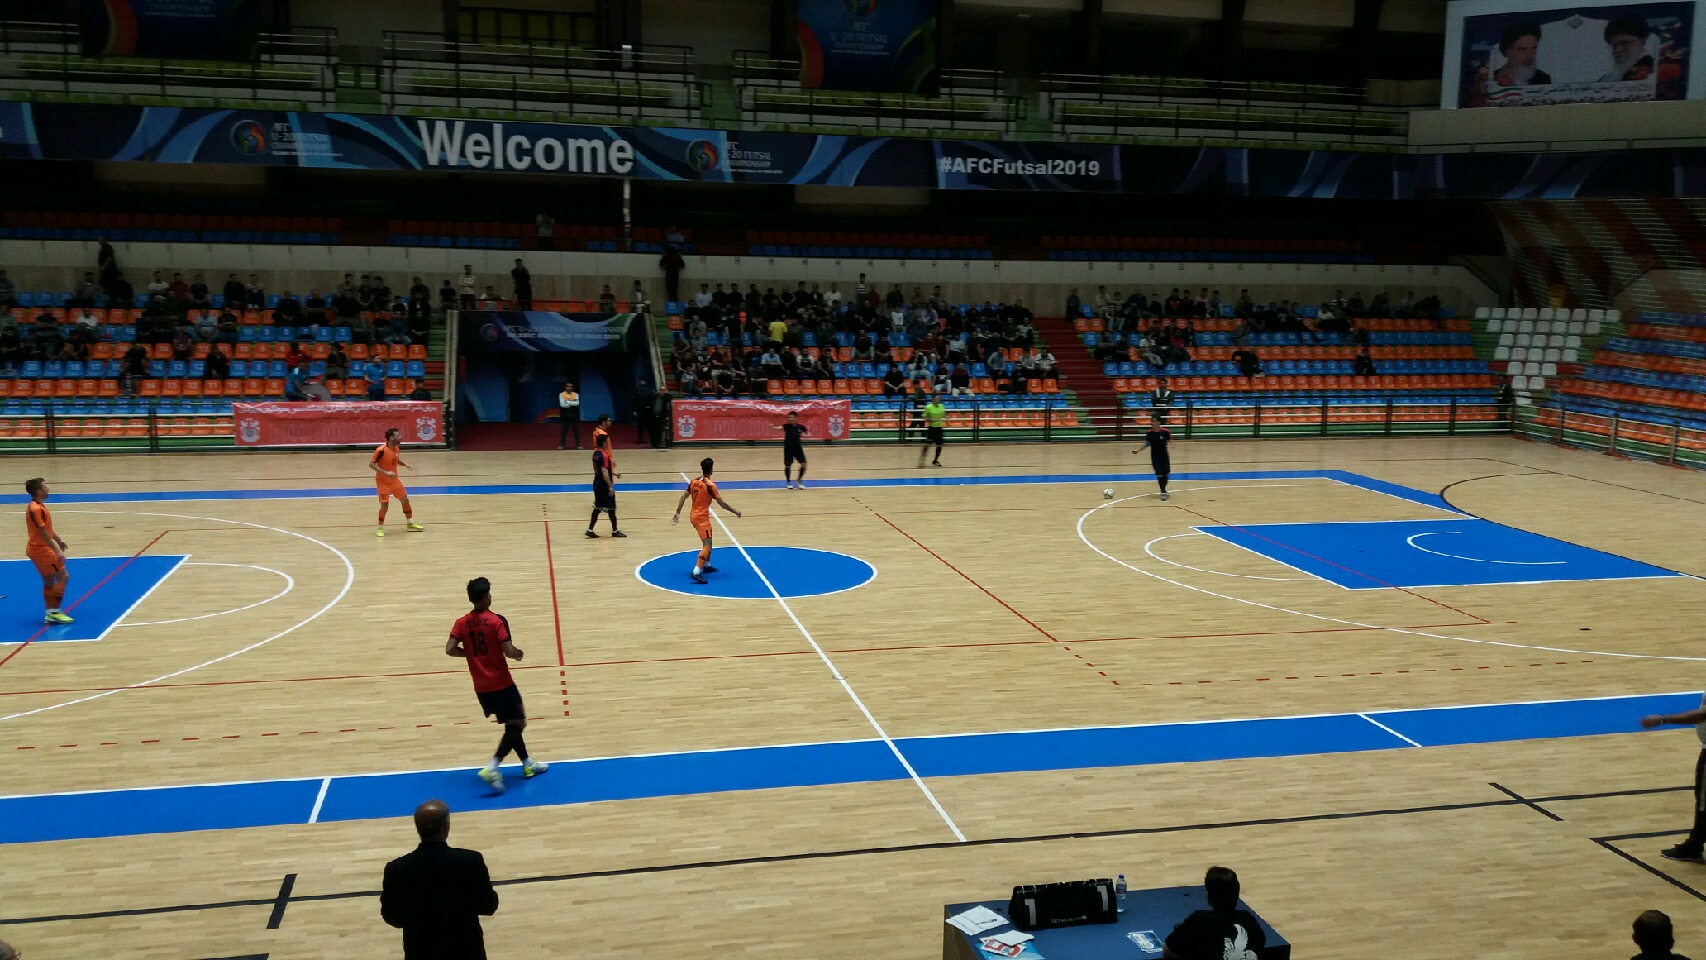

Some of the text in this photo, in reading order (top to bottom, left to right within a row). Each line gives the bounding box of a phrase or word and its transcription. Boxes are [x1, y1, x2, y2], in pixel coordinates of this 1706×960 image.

[417, 120, 634, 174] Welcome
[940, 156, 1100, 176] #AFCFutsal2019
[468, 630, 488, 656] 18
[1024, 885, 1109, 926] 1 1
